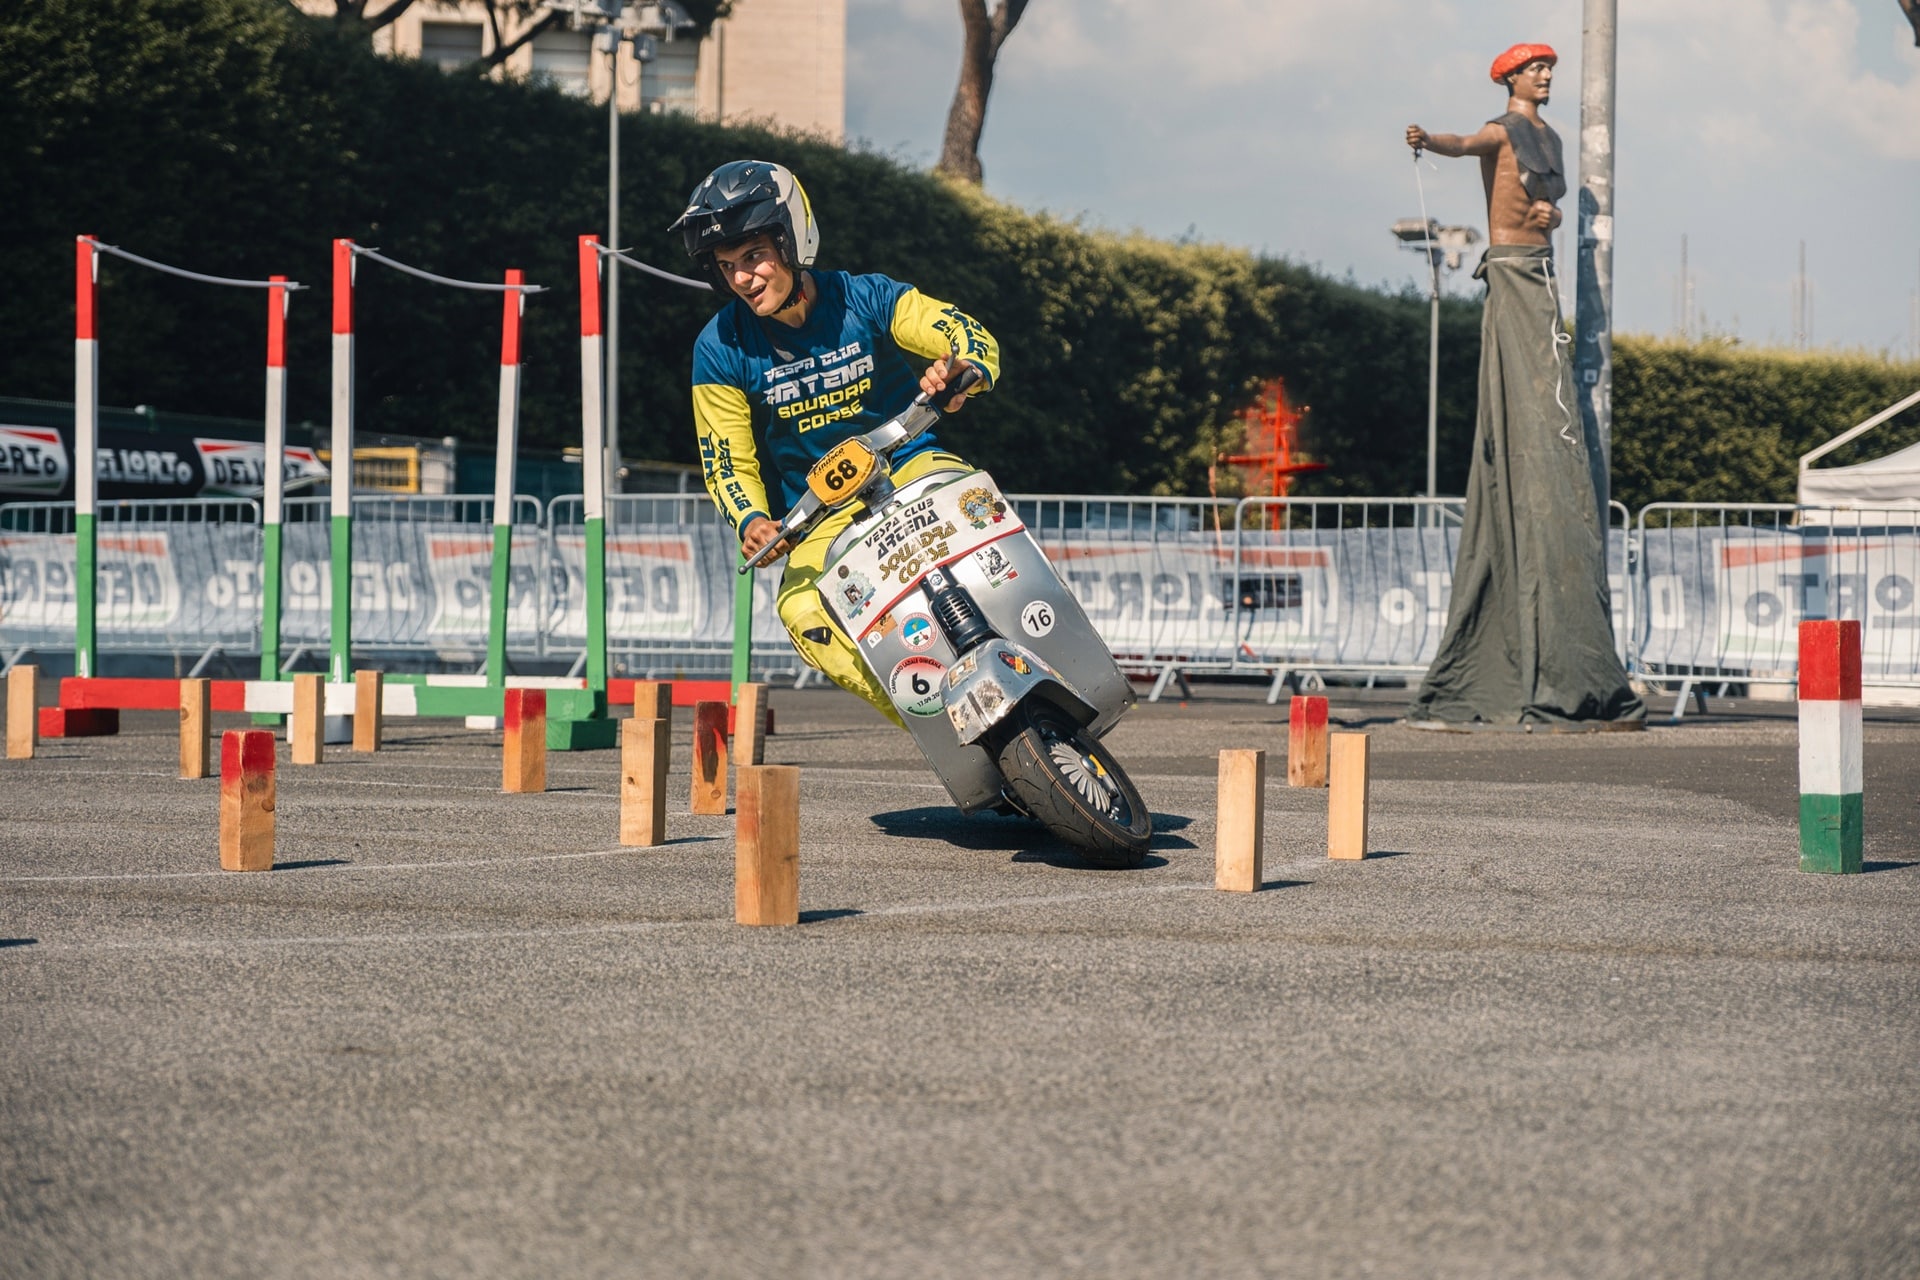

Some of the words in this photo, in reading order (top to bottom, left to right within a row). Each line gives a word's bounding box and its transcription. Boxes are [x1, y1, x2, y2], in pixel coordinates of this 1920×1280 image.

[763, 357, 815, 383] VESPA
[819, 341, 861, 366] CLUB
[778, 377, 871, 419] SQUADRA
[798, 399, 863, 434] CORSE
[825, 459, 858, 490] 68
[865, 517, 900, 548] VESPA
[904, 498, 934, 518] CLUB
[1028, 608, 1052, 632] 16
[912, 671, 930, 695] 6
[917, 691, 940, 707] 17.09.20
